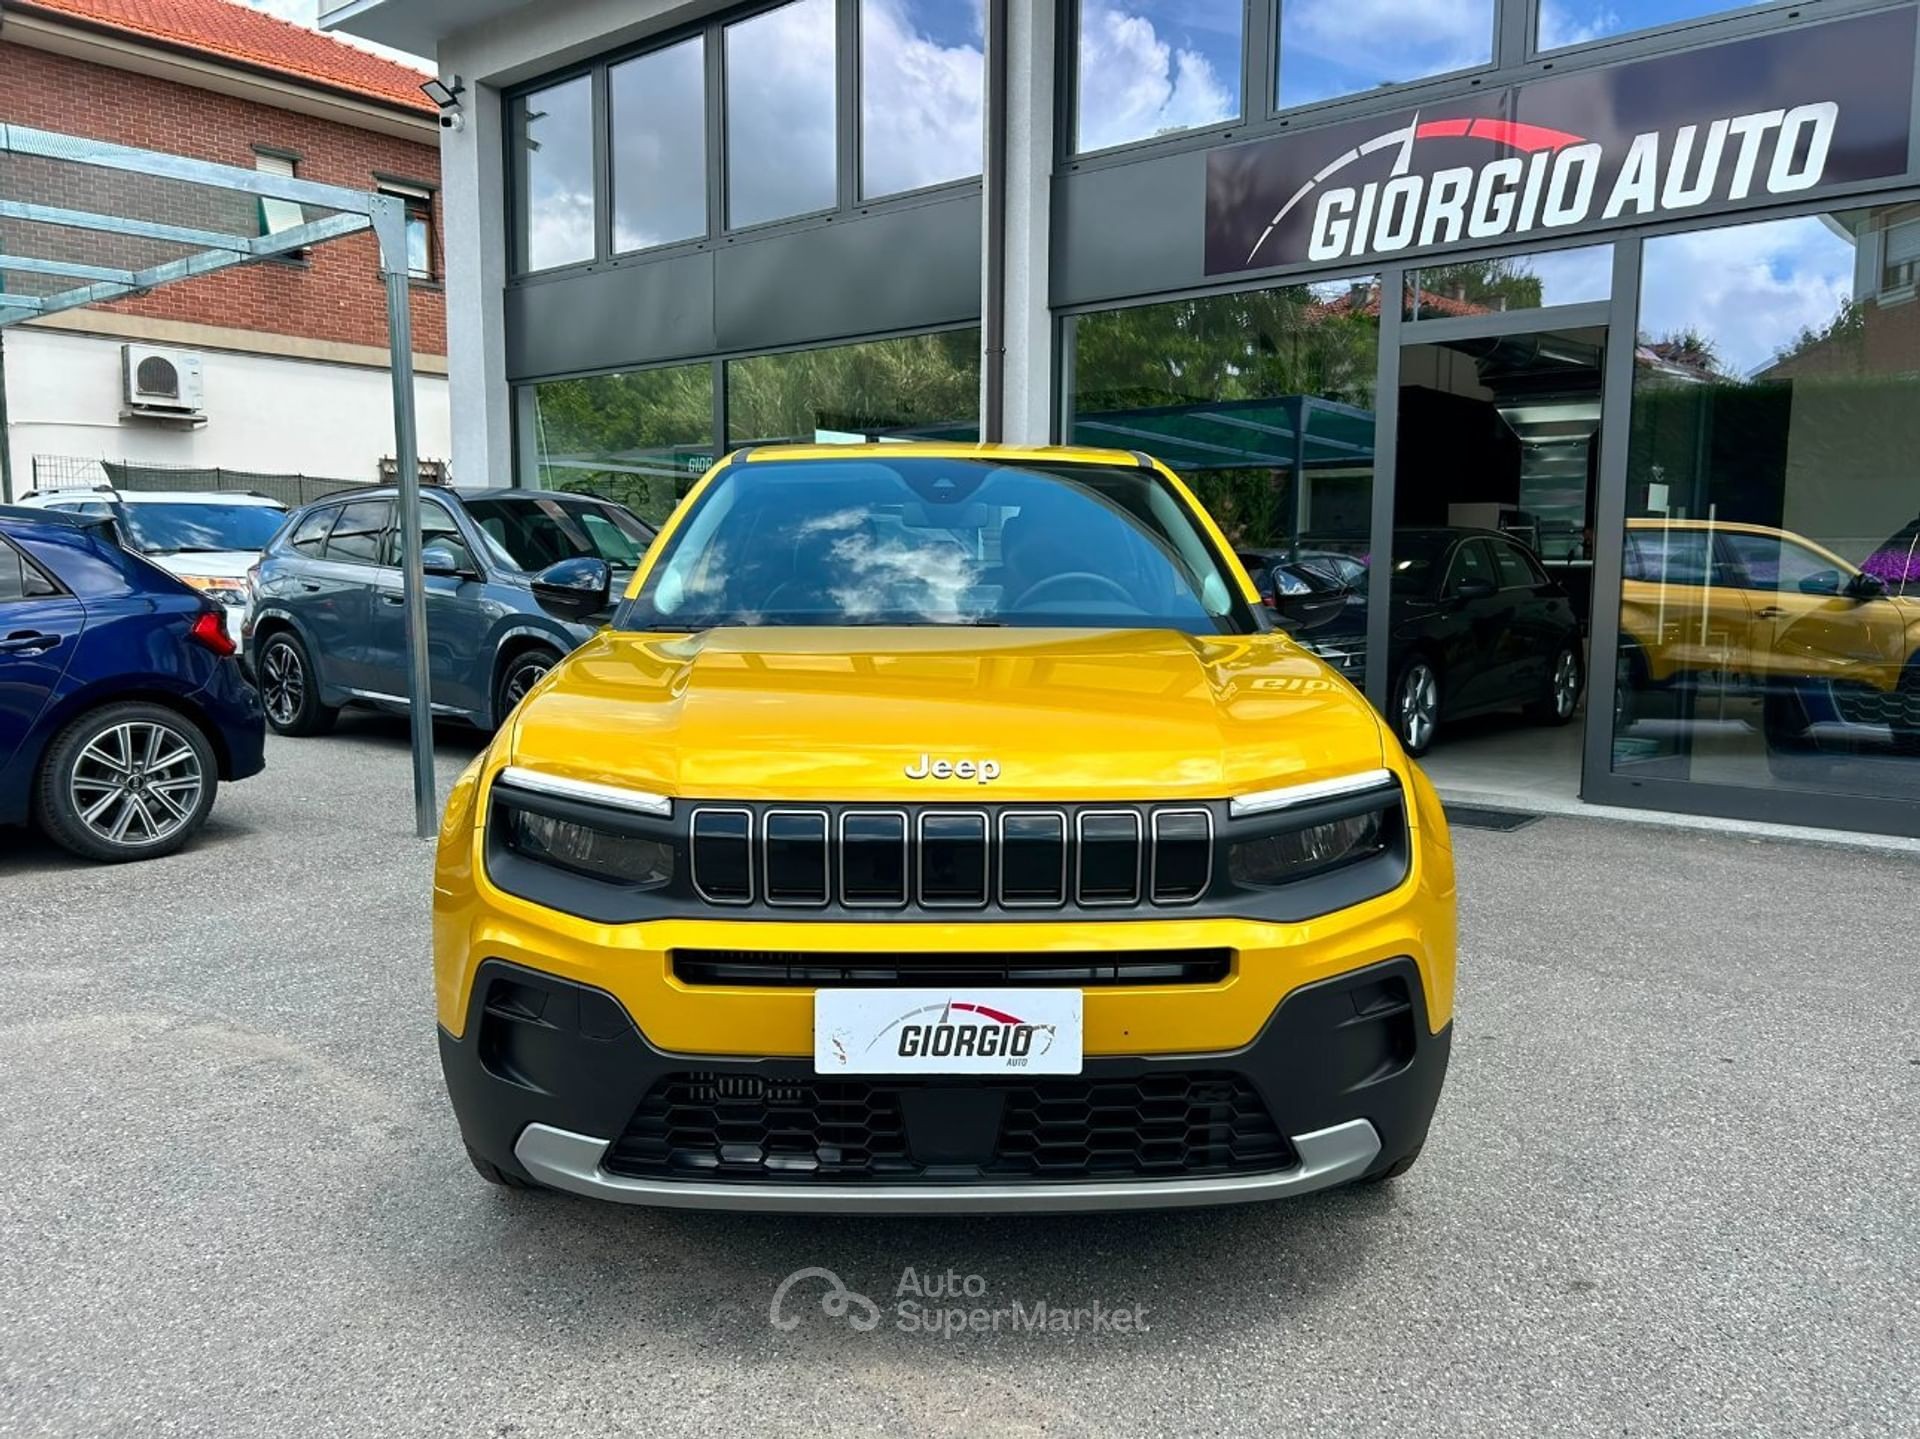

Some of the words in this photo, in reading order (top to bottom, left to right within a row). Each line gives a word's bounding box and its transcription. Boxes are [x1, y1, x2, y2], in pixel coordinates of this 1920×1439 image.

[1308, 142, 1602, 262] GIORGIO
[1602, 101, 1838, 219] AUTO
[904, 753, 1001, 784] Jeep
[898, 1025, 1034, 1057] GIORGIO
[1006, 1058, 1029, 1067] AUTO
